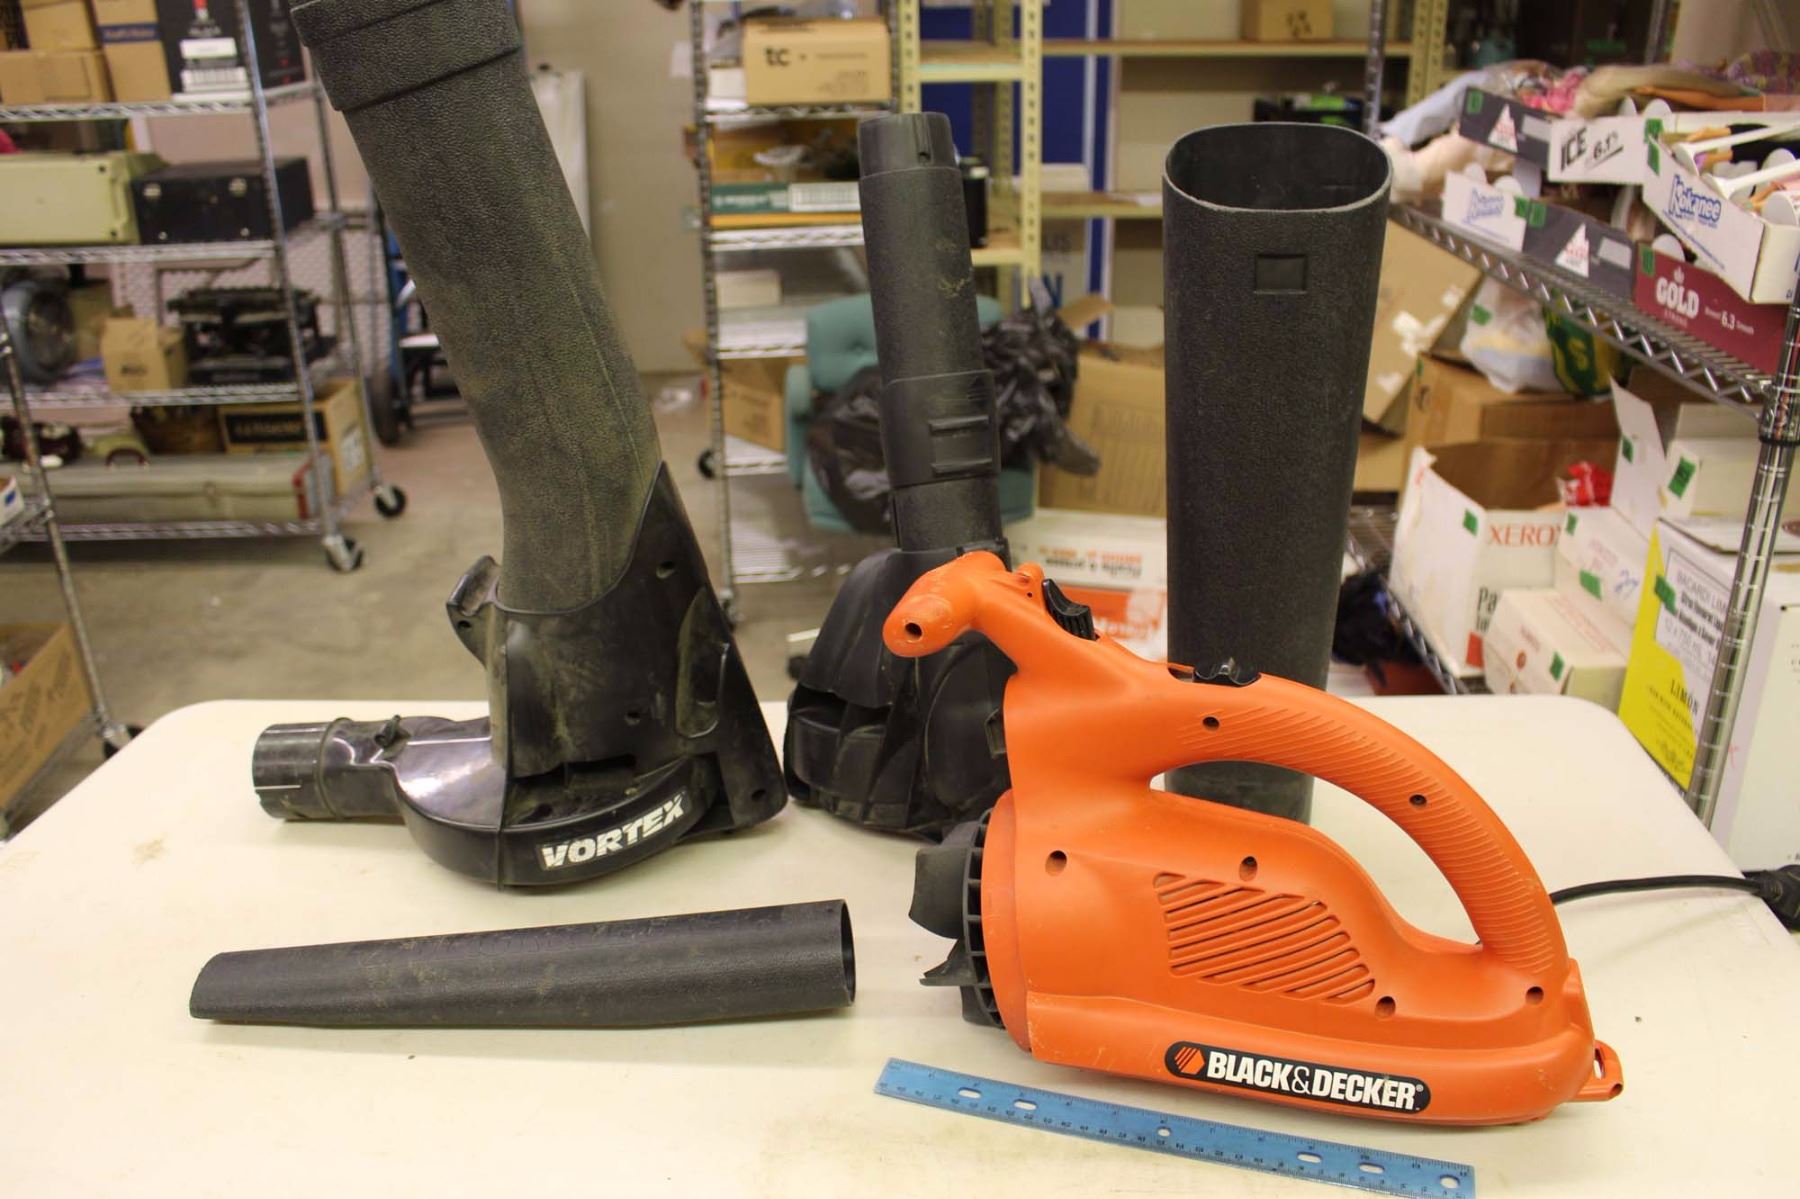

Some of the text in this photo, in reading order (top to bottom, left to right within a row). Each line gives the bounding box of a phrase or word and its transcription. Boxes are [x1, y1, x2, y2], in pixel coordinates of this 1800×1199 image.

[1561, 126, 1587, 172] ICE
[1668, 174, 1722, 222] Kokanee
[1656, 277, 1699, 319] GOLD
[542, 792, 686, 869] VORTEX
[1207, 1050, 1418, 1111] BLACK&DECKER
